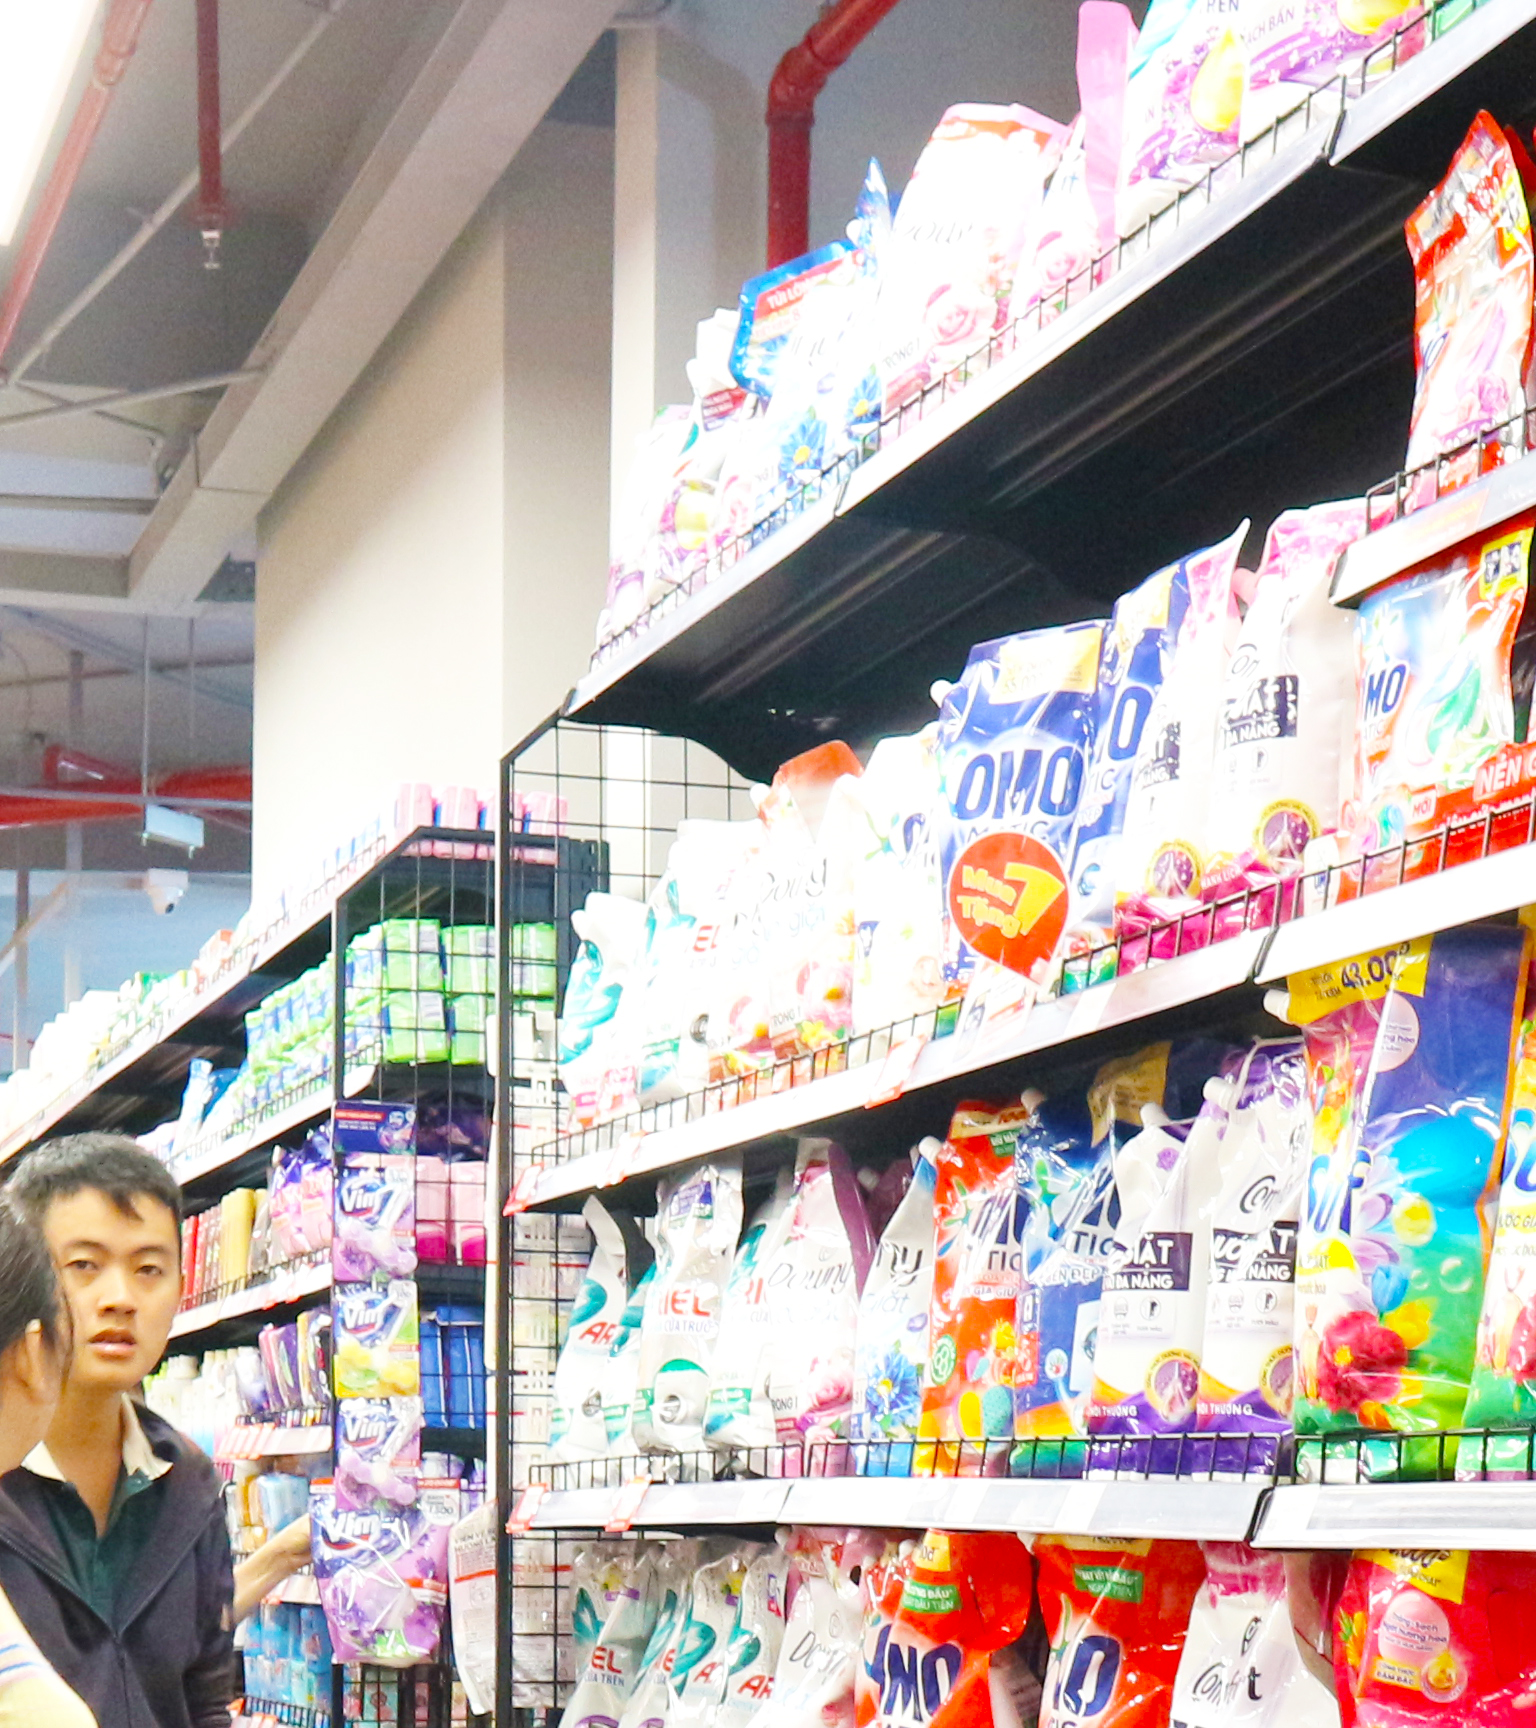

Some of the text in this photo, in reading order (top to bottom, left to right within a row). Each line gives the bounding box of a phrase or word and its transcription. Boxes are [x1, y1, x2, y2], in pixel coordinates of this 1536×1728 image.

[955, 745, 1084, 820] OMO
[961, 864, 1018, 906] Mua
[658, 1289, 712, 1317] IEL
